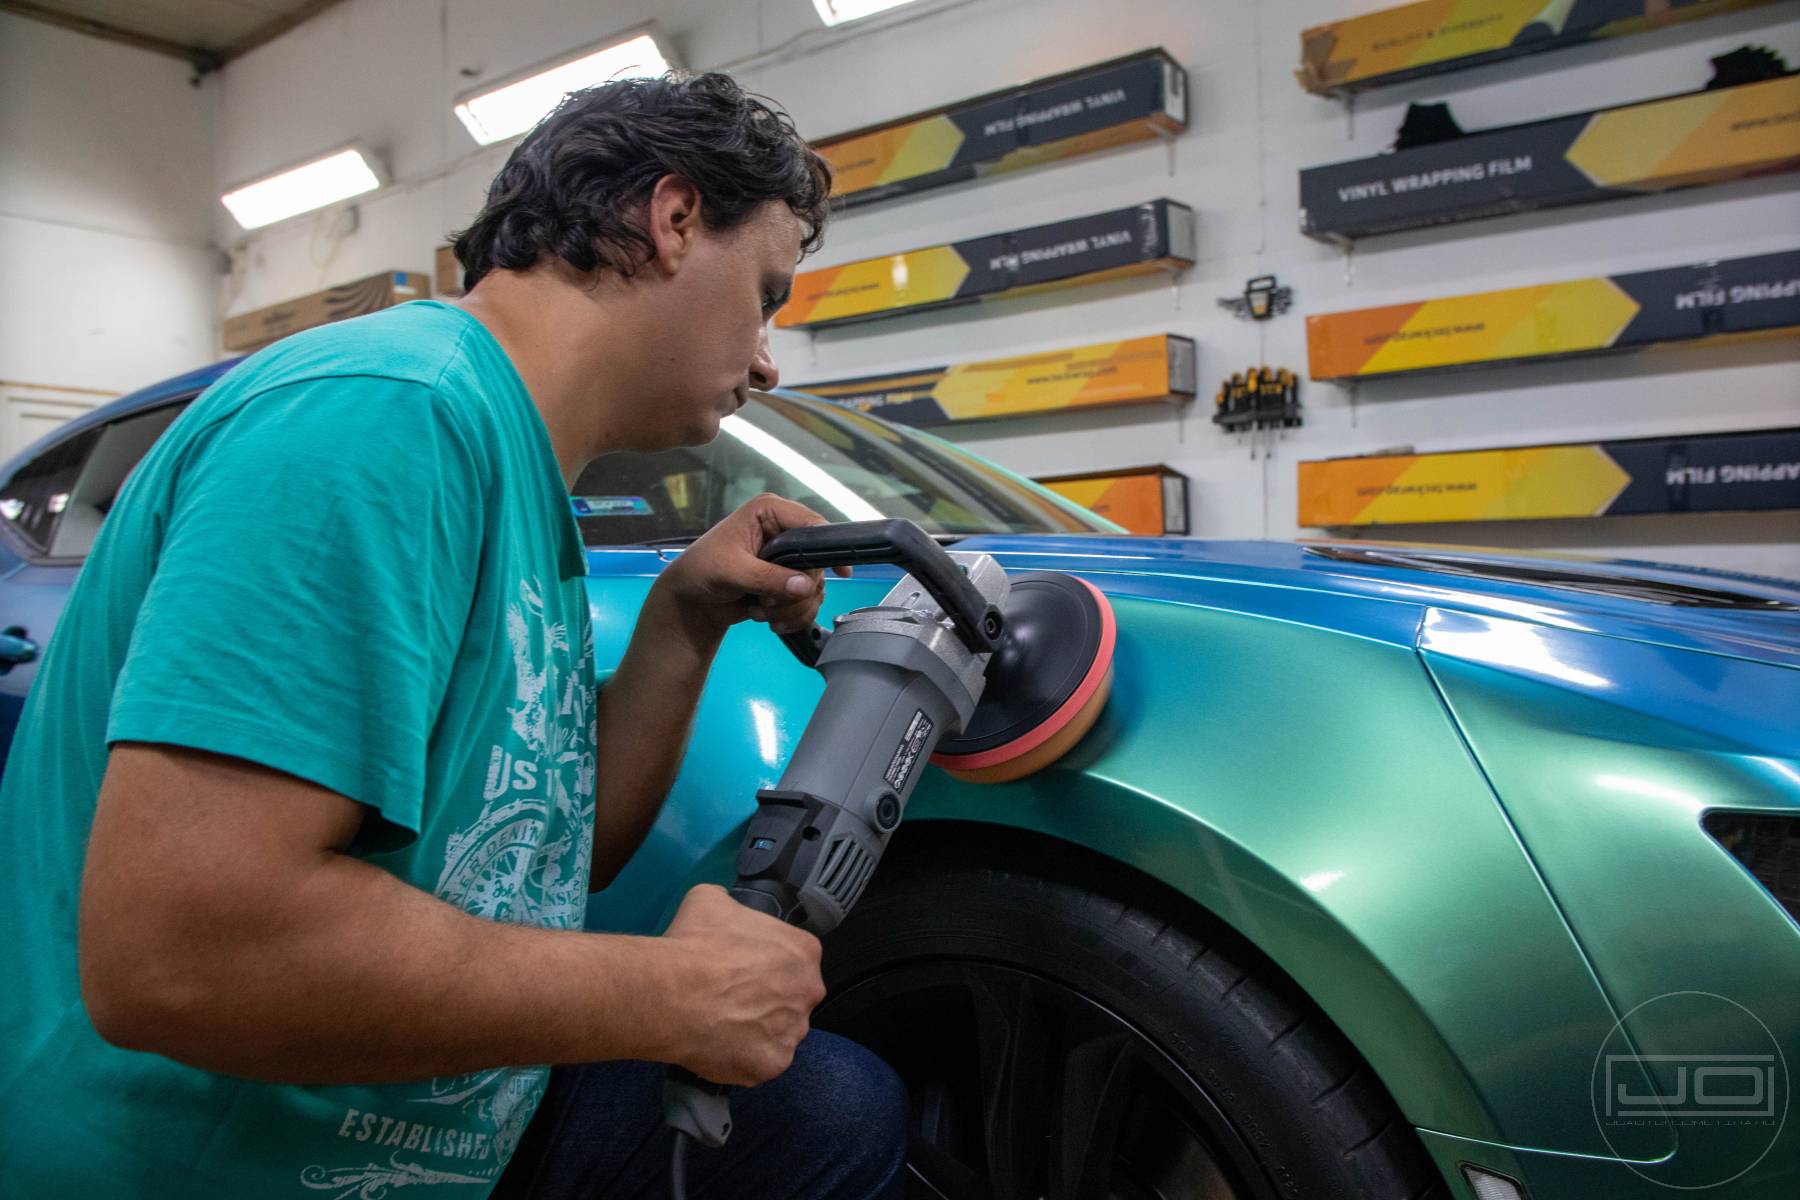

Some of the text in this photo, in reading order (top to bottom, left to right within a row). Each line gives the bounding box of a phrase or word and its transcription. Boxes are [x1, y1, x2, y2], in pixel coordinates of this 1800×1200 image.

[984, 88, 1126, 137] VINYL WRAPPING FILM
[1339, 155, 1532, 202] VINYL WRAPPING FILM
[1021, 239, 1089, 264] WRAPPING
[1089, 230, 1132, 250] VINYL
[1674, 288, 1727, 310] FILM
[1666, 466, 1717, 486] FILM
[338, 1108, 491, 1161] ESTABLISHED
